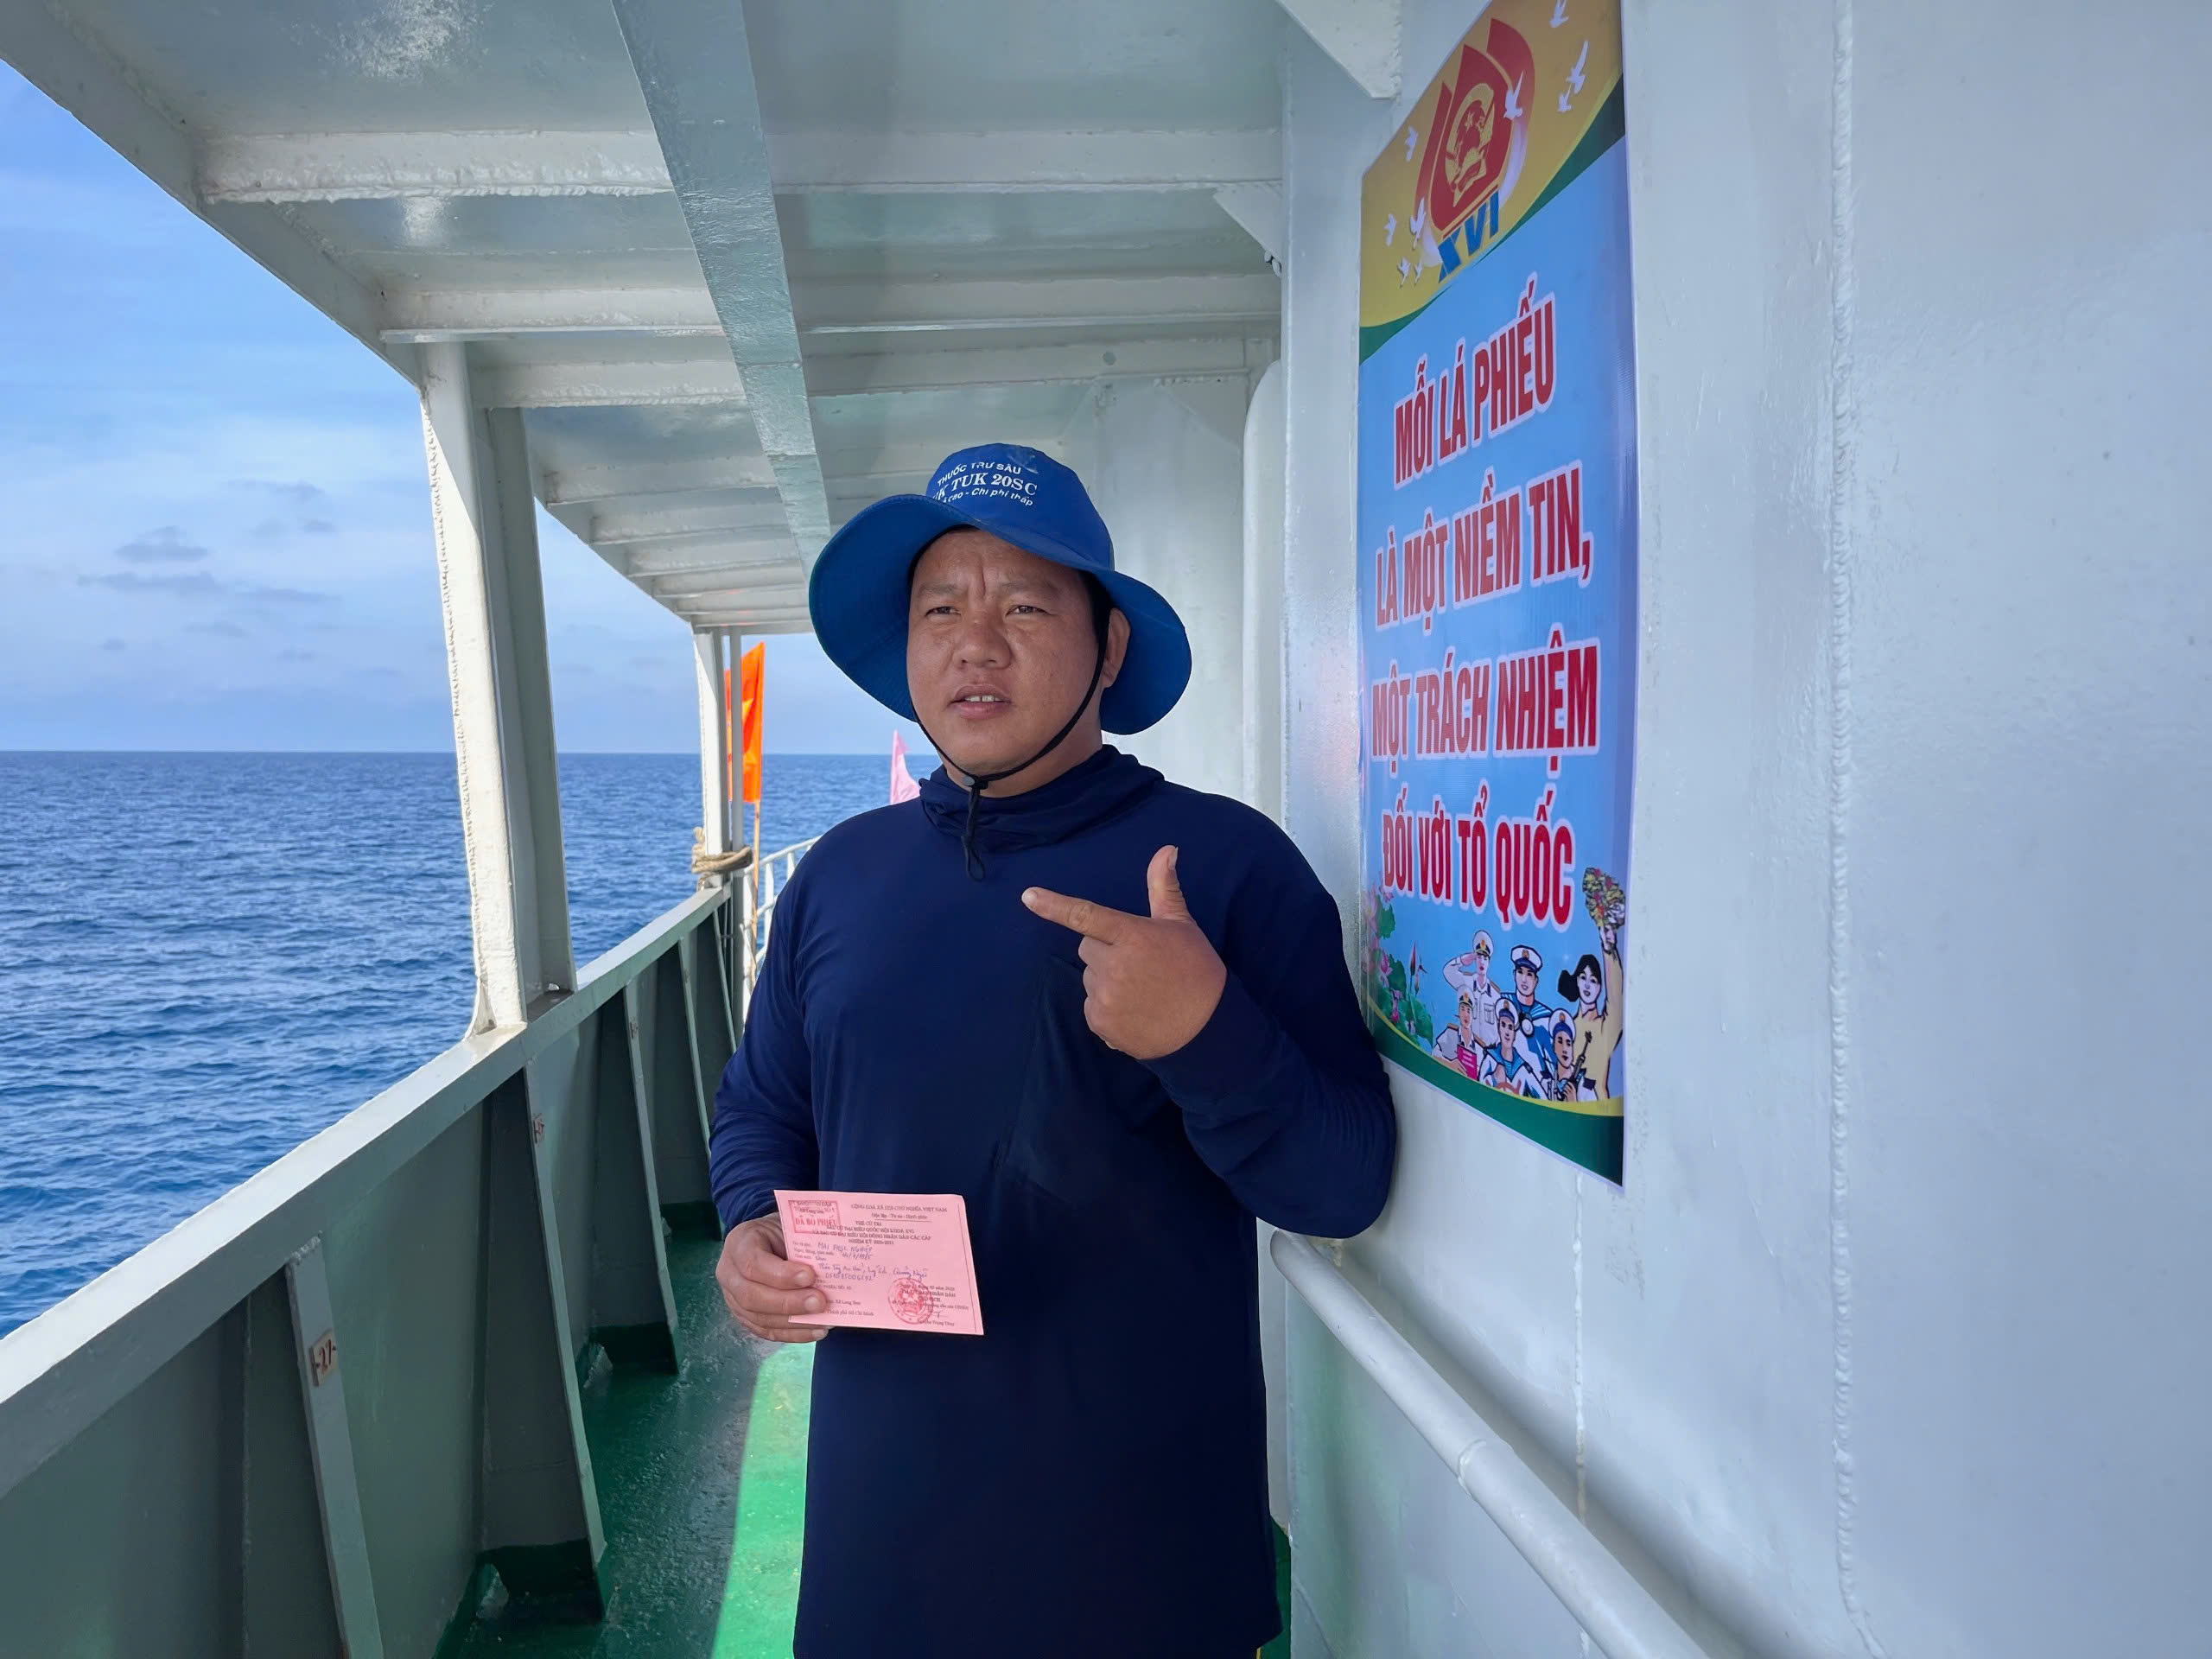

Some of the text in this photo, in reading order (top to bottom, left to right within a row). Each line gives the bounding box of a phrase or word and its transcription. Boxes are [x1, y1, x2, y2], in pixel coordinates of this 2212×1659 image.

[1438, 191, 1499, 283] XVI
[1395, 279, 1554, 484] MỖI LÁ PHIẾU
[951, 473, 988, 492] TUK
[991, 474, 1038, 496] 20SC
[996, 461, 1021, 475] SÂU
[1377, 467, 1591, 630] LÀ MỘT NIỀM TIN,
[1372, 630, 1597, 773] MỘT TRÁCH NHIỆM
[1382, 785, 1573, 925] ĐỐI VỚI TỔ QUỐC
